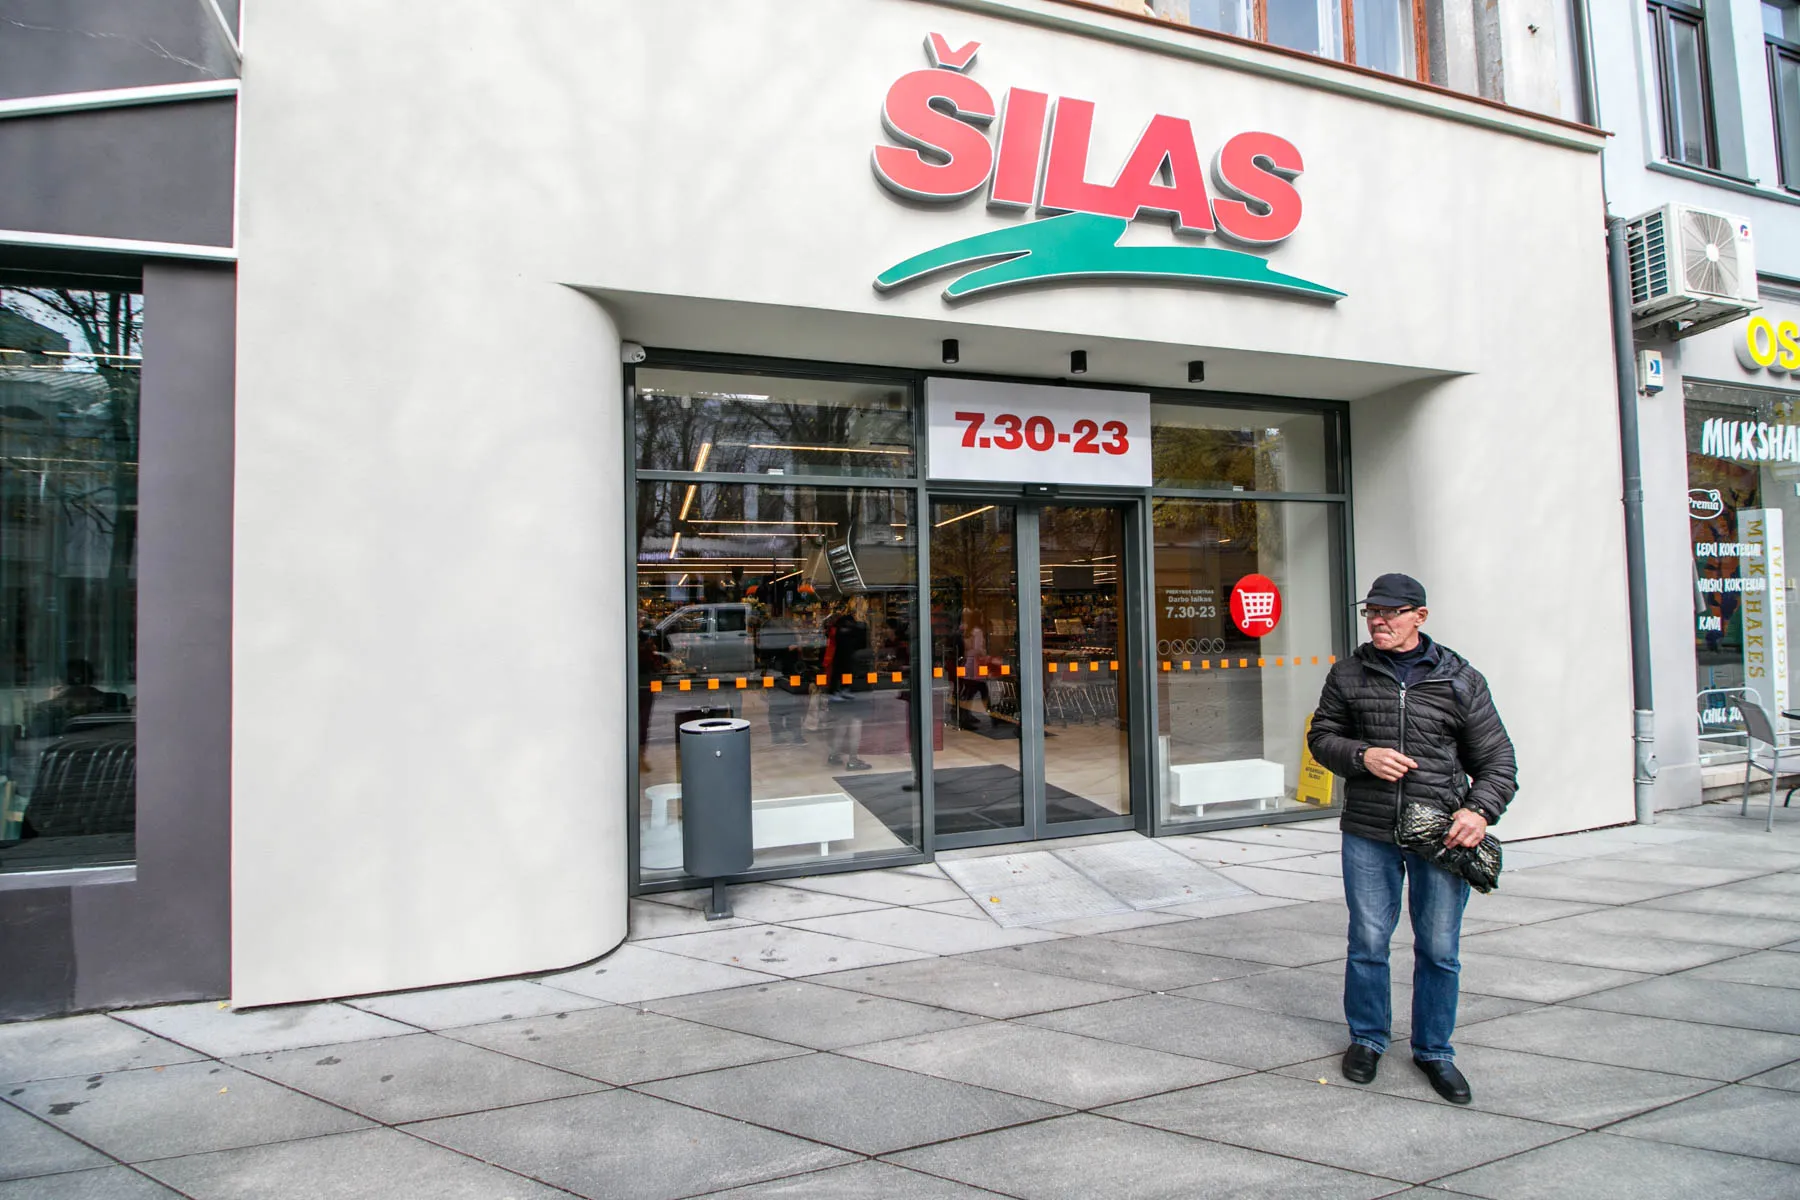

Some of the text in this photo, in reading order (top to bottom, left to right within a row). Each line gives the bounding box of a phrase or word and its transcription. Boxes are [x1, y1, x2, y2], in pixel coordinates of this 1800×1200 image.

[871, 31, 1305, 245] ŠILAS
[955, 411, 1130, 455] 7.30-23
[1165, 606, 1216, 618] 7.30-23
[1699, 615, 1721, 631] KAVA
[1703, 707, 1726, 724] CHILL
